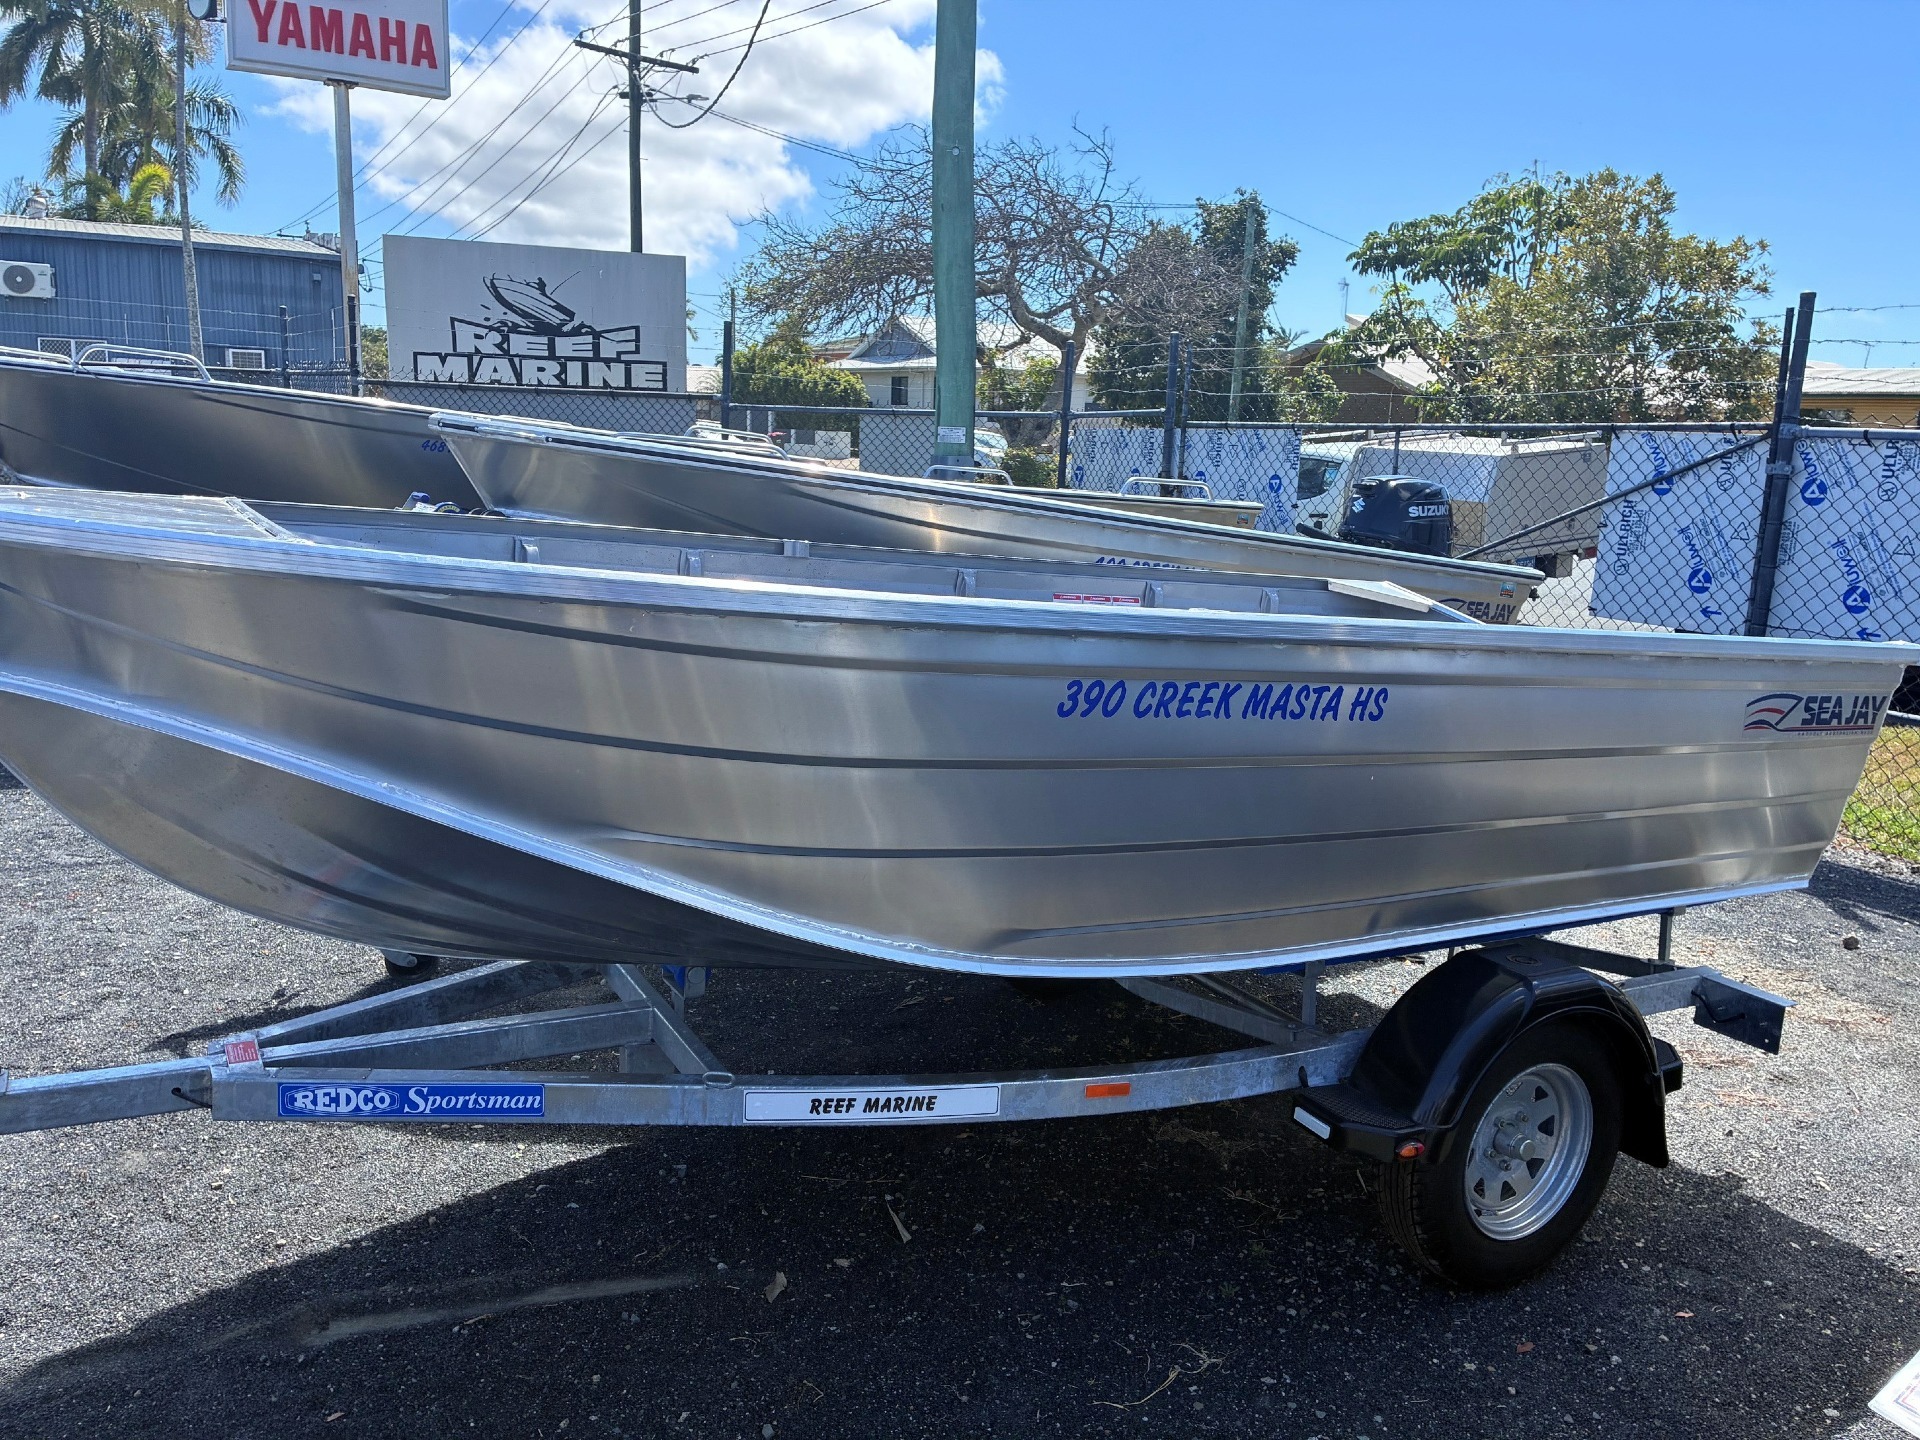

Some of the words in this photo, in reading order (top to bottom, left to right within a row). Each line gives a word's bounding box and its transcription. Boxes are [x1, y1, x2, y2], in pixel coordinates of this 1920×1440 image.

[248, 0, 438, 69] YAMAHA
[451, 318, 638, 359] REEF
[415, 354, 665, 390] MARINE
[1830, 537, 1871, 615] Aluwell
[1466, 601, 1490, 619] SEA
[1491, 603, 1516, 621] JAY
[1057, 680, 1126, 718] 390
[1133, 682, 1242, 719] CREEK
[1242, 683, 1344, 721] MASTA
[1349, 687, 1388, 722] HS
[1801, 696, 1843, 725] SEA
[1844, 696, 1887, 724] JAY
[293, 1088, 391, 1113] REDCO
[404, 1087, 541, 1114] Sportsman
[809, 1098, 857, 1115] REEF
[863, 1095, 937, 1113] MARINE
